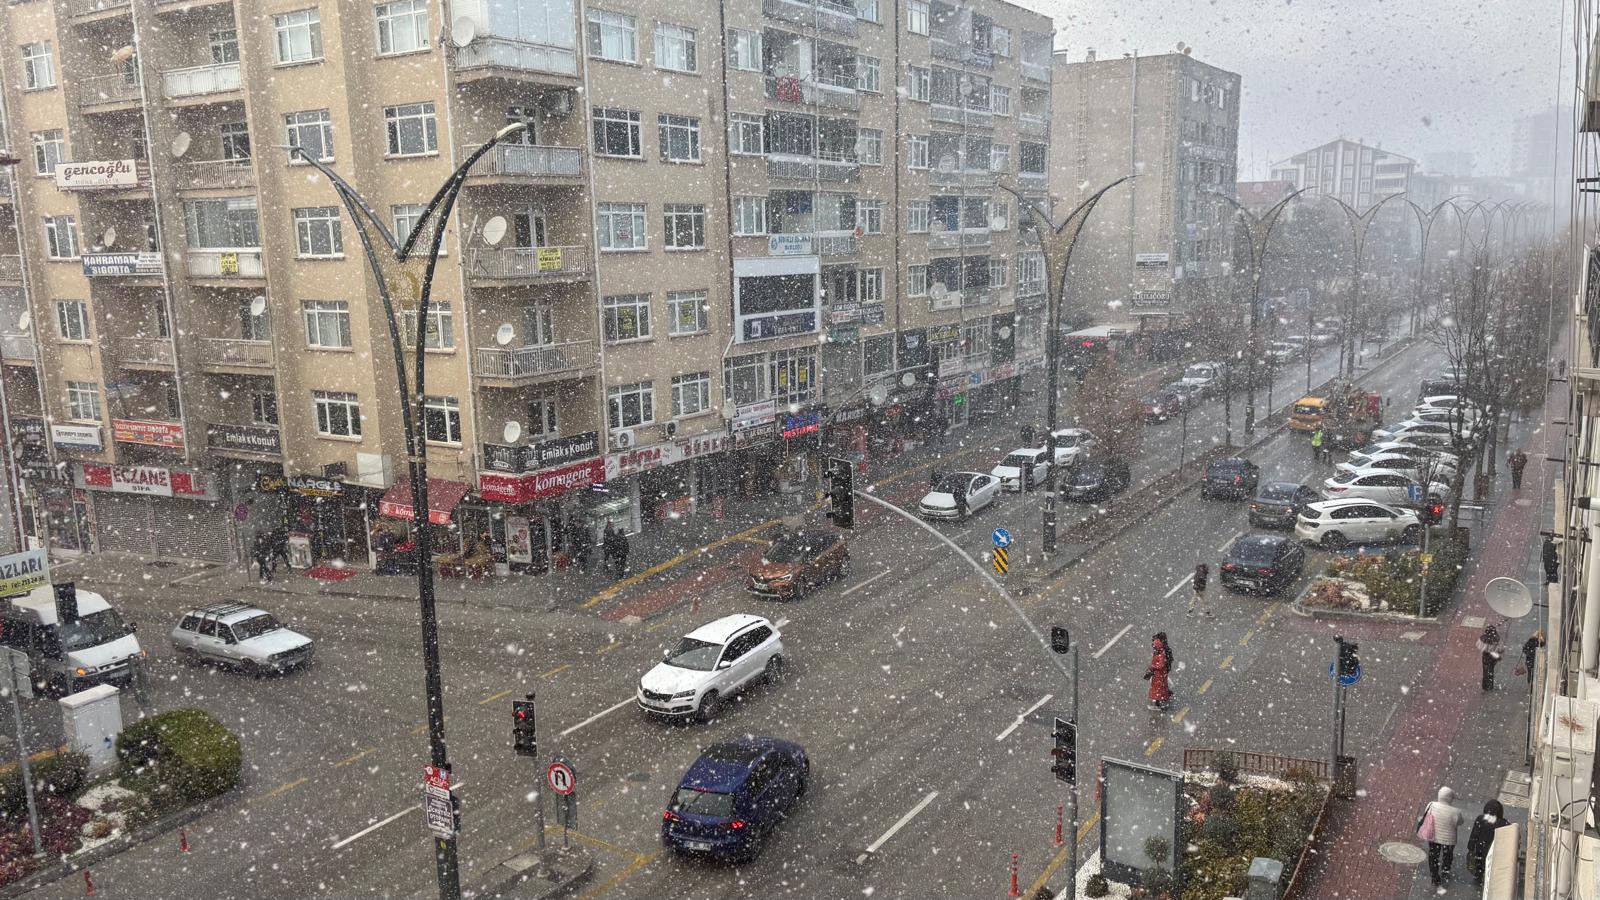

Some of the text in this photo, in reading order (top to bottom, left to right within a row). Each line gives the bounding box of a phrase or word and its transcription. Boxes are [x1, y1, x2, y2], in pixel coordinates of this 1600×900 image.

[250, 435, 276, 447] Konut
[541, 445, 564, 461] Emlak
[569, 439, 594, 457] Konut
[113, 466, 168, 487] ECZANE
[535, 467, 593, 493] komagene
[482, 481, 515, 496] komagene
